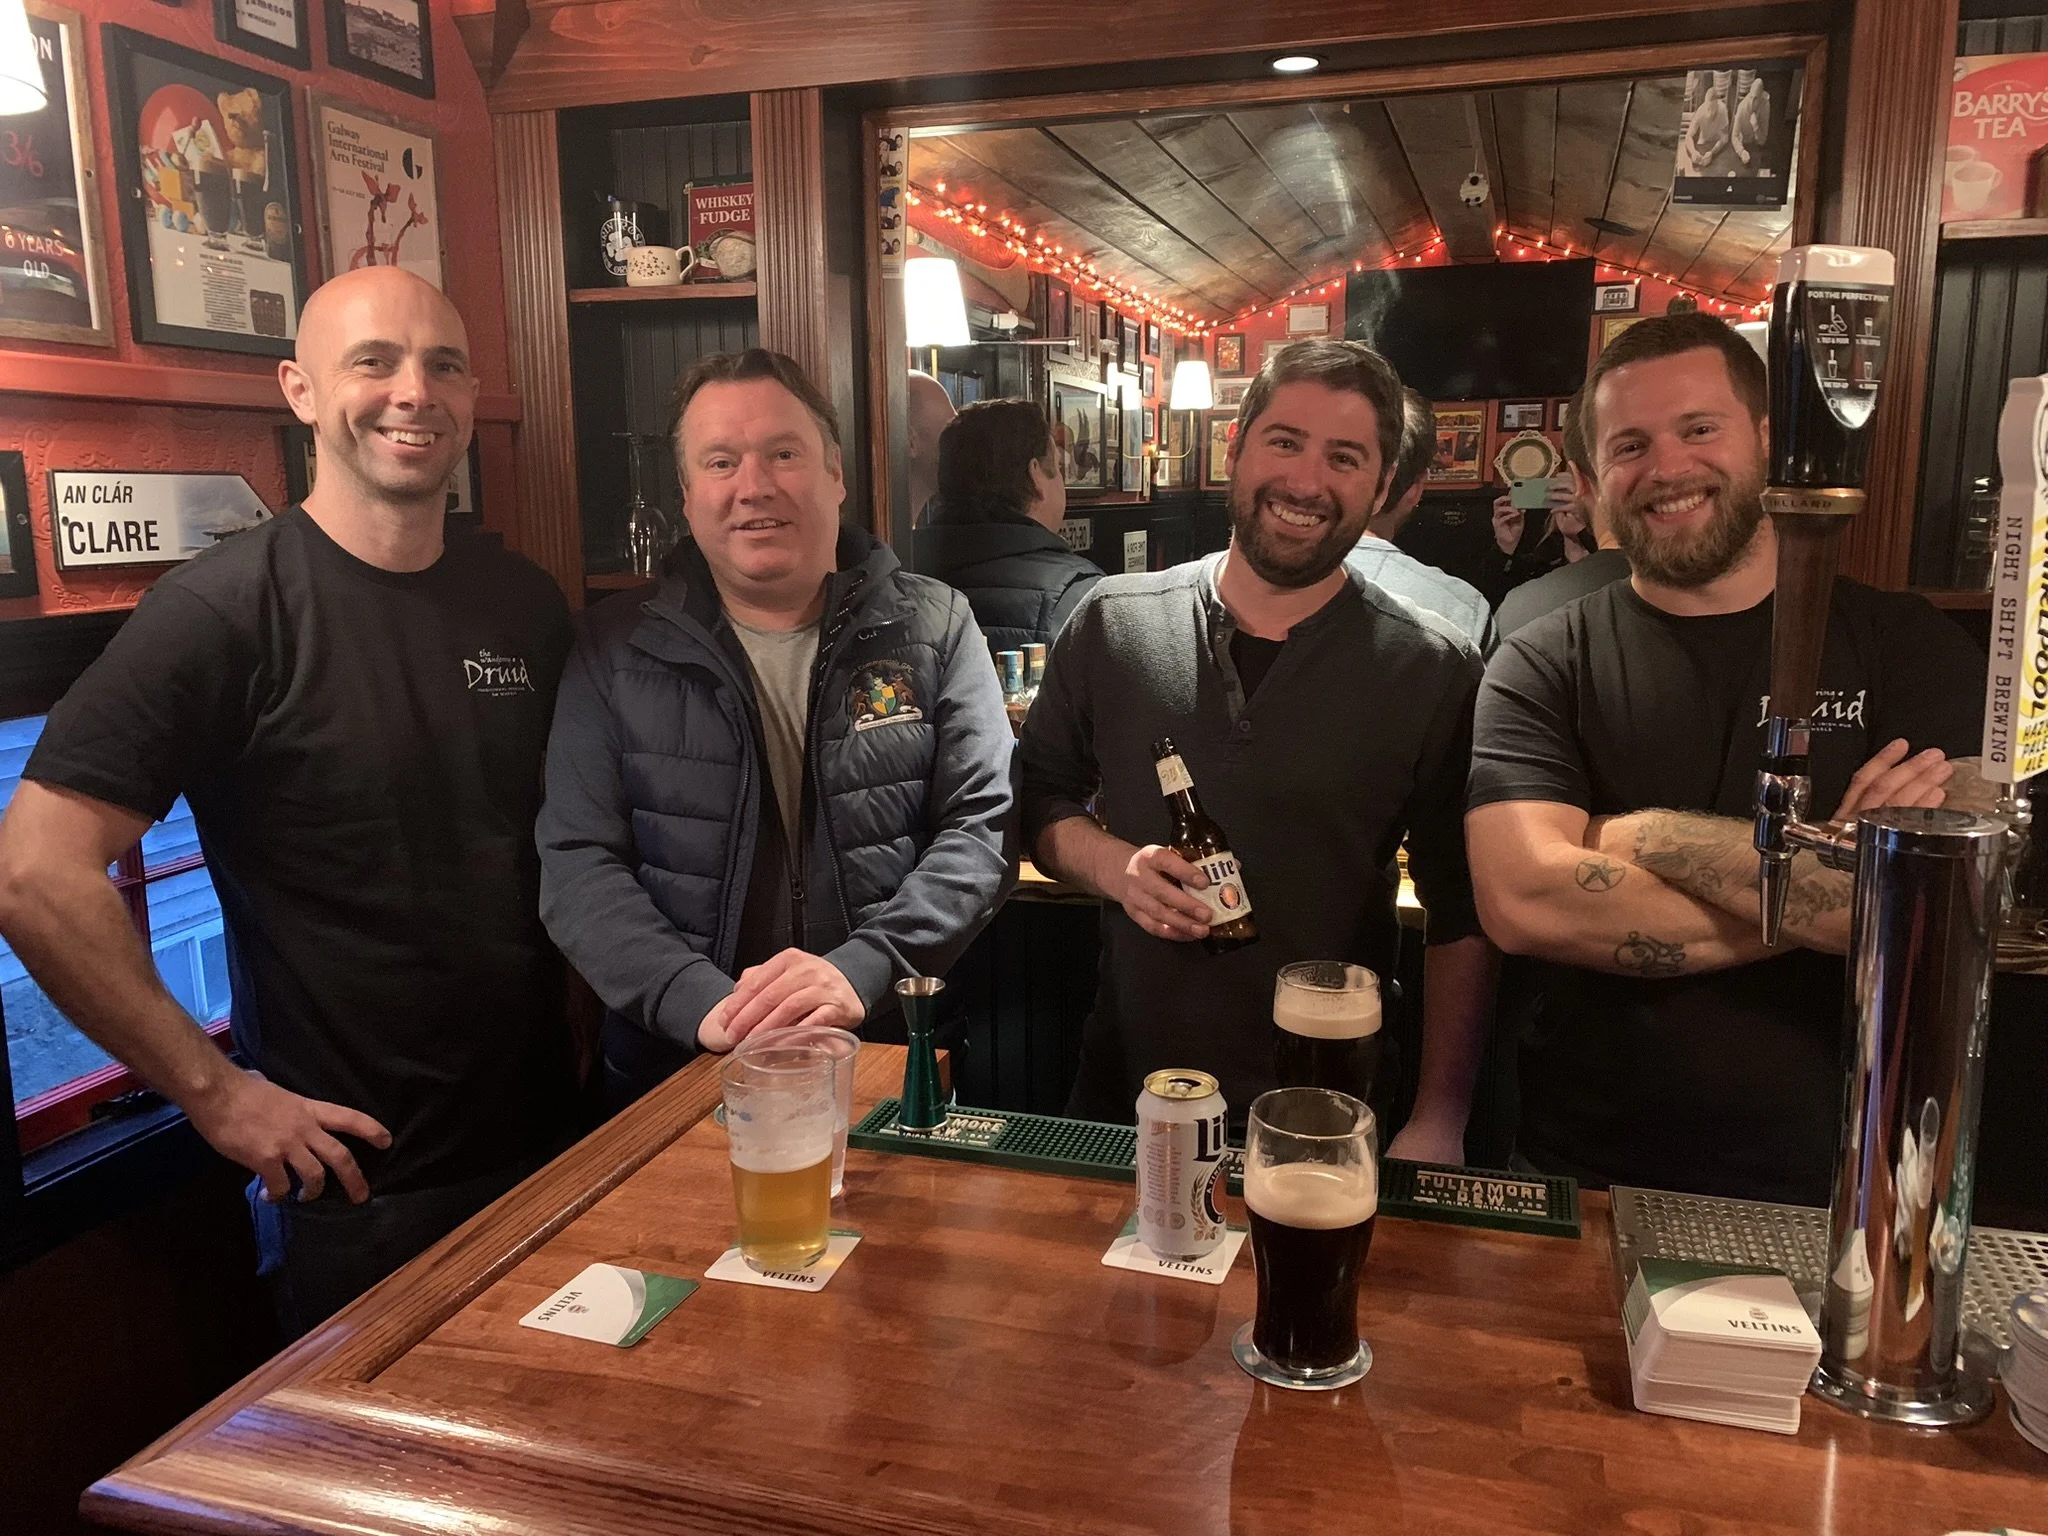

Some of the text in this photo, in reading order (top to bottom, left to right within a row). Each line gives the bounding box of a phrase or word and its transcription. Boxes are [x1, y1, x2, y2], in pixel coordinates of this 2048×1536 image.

[327, 120, 360, 143] Galway
[1973, 116, 2027, 139] TEA
[328, 134, 389, 161] International
[329, 148, 385, 173] Arts Festival
[695, 192, 754, 209] WHISKEY
[700, 208, 751, 225] FUDGE
[4, 231, 65, 257] 6 YEARS
[23, 258, 50, 278] OLD
[1808, 290, 1823, 298] FOR
[1824, 291, 1840, 299] THE
[1841, 292, 1873, 301] PERFECT
[63, 481, 133, 504] AN CLÁR
[68, 520, 160, 555] CLARE
[1989, 516, 2023, 763] NIGHT SHIFT BREWING
[463, 657, 536, 692] Druid
[2023, 718, 2048, 742] HAZ
[2020, 738, 2048, 760] PALE
[2024, 753, 2045, 774] ALE
[951, 1117, 1005, 1134] MORE
[1417, 1174, 1546, 1200] TULLAMORE
[1457, 1190, 1504, 1206] DEW
[762, 1271, 816, 1284] VELTINS
[1158, 1260, 1214, 1275] VELTINS
[537, 1290, 583, 1322] VELTINS
[1727, 1319, 1802, 1334] VELTINS
